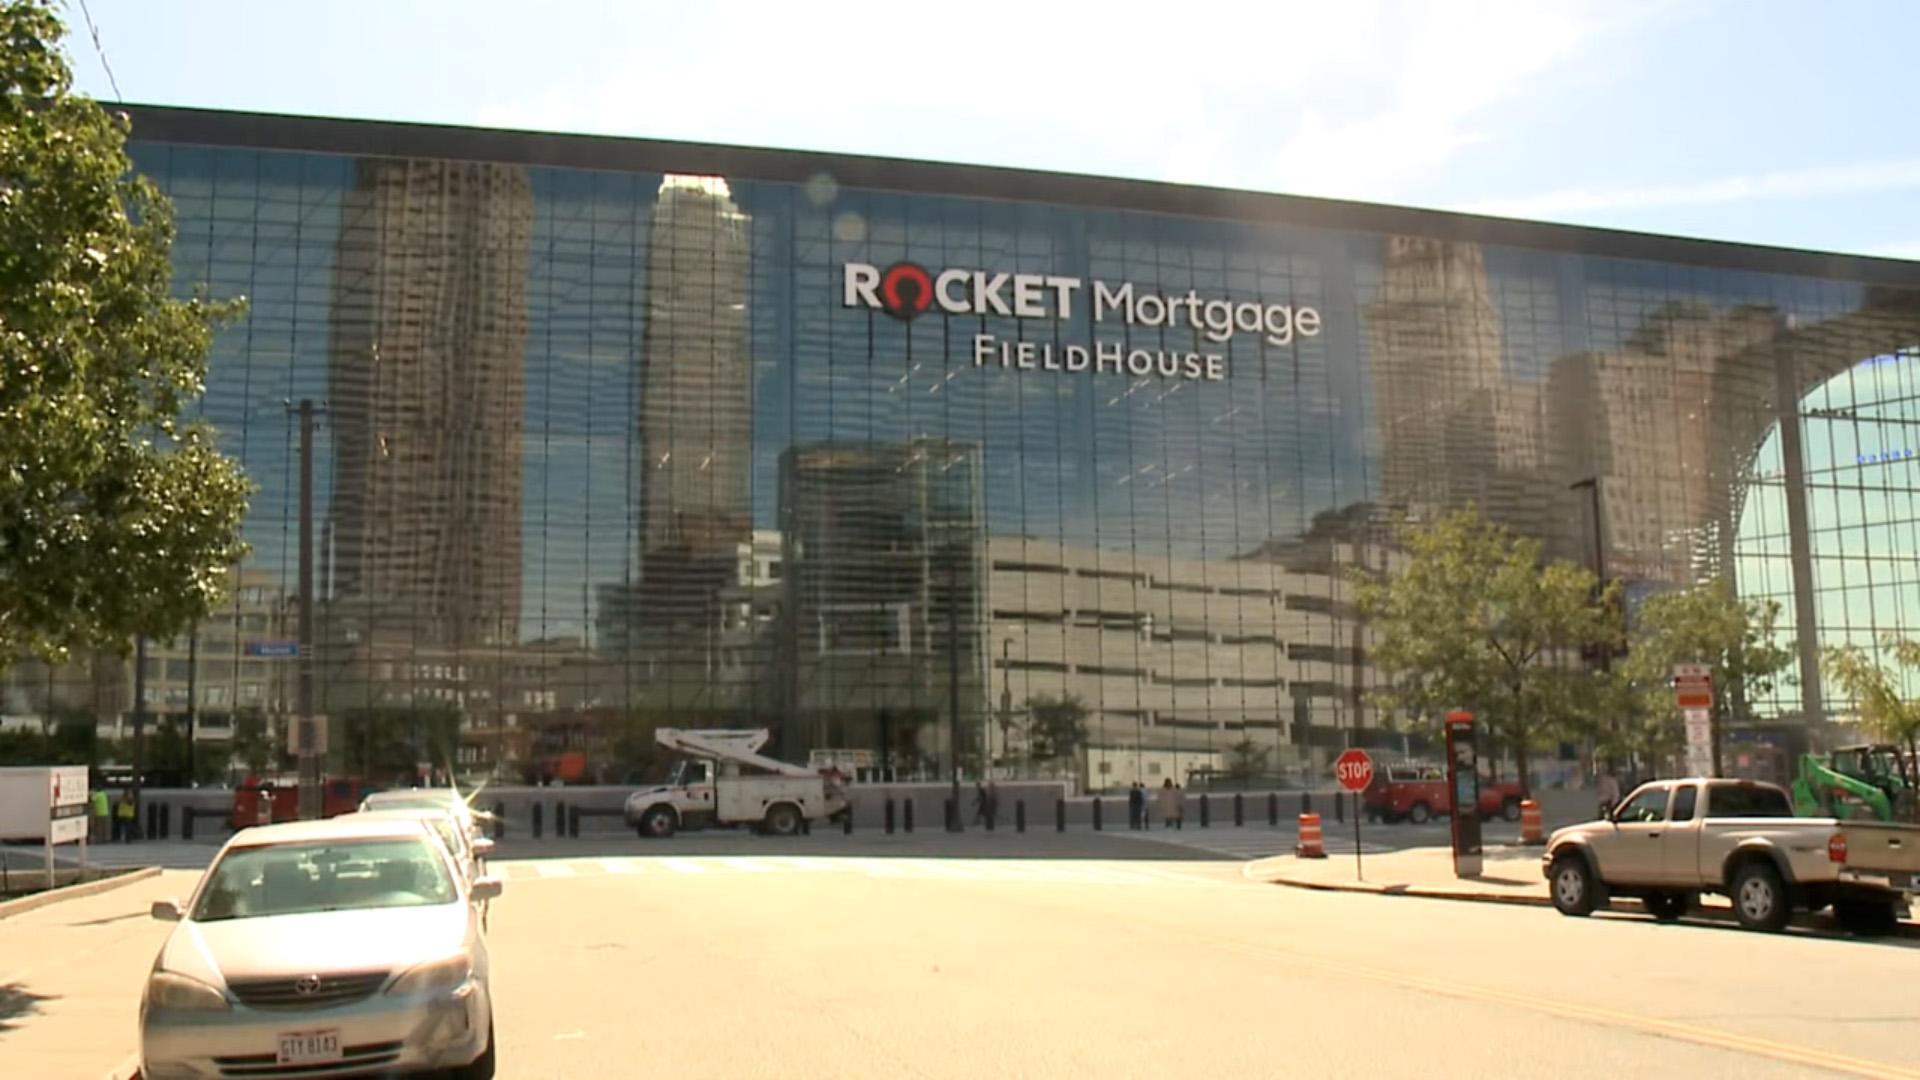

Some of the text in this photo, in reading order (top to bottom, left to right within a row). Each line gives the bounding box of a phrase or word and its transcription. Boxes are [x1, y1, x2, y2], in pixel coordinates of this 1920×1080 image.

[844, 262, 1321, 346] ROCKET Mortgage
[974, 333, 1225, 380] FIELDHOUSE
[1339, 762, 1370, 779] STOP
